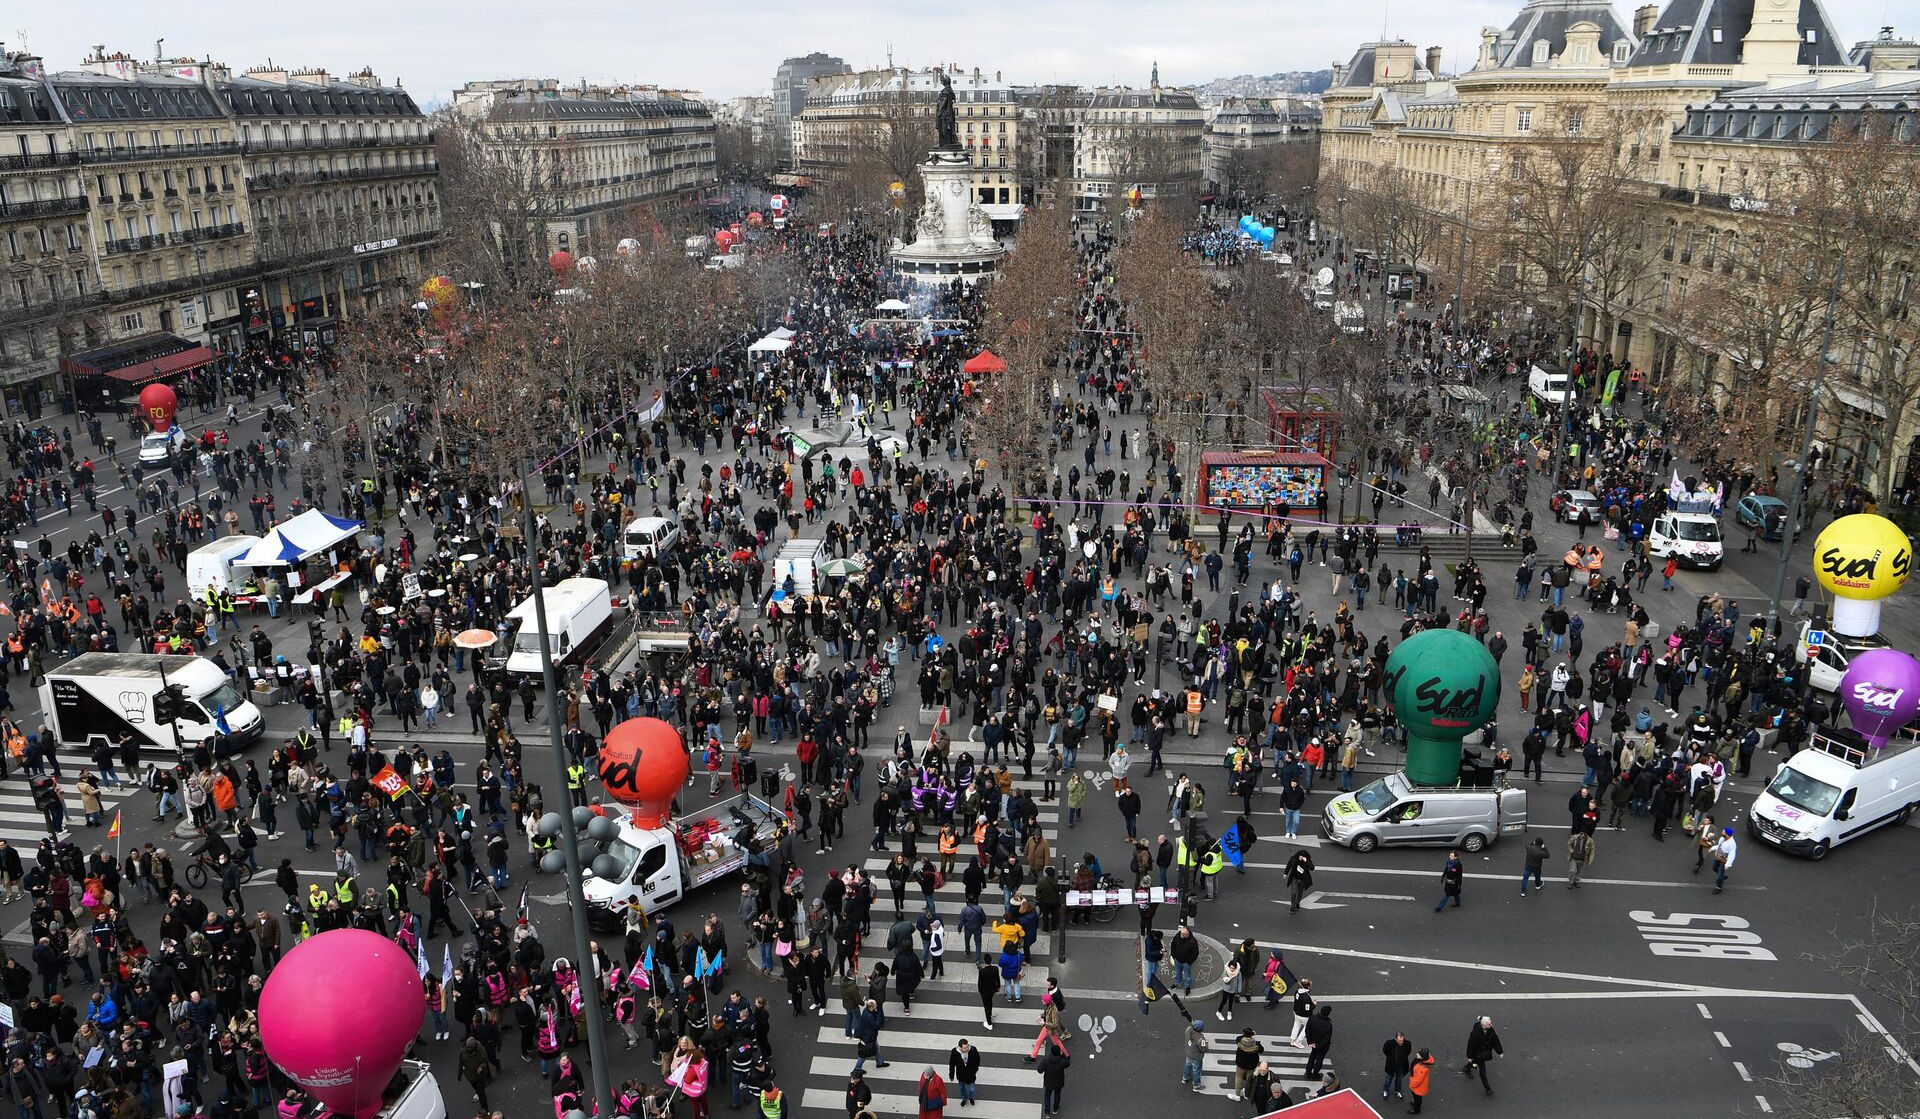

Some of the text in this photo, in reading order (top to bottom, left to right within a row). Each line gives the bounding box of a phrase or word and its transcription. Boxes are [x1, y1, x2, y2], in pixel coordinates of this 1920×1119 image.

[150, 407, 164, 419] FO
[1822, 547, 1882, 580] Sud
[1892, 548, 1911, 578] Su
[1415, 674, 1486, 715] Sud
[1853, 682, 1904, 710] Sud
[1628, 910, 1779, 961] BUS
